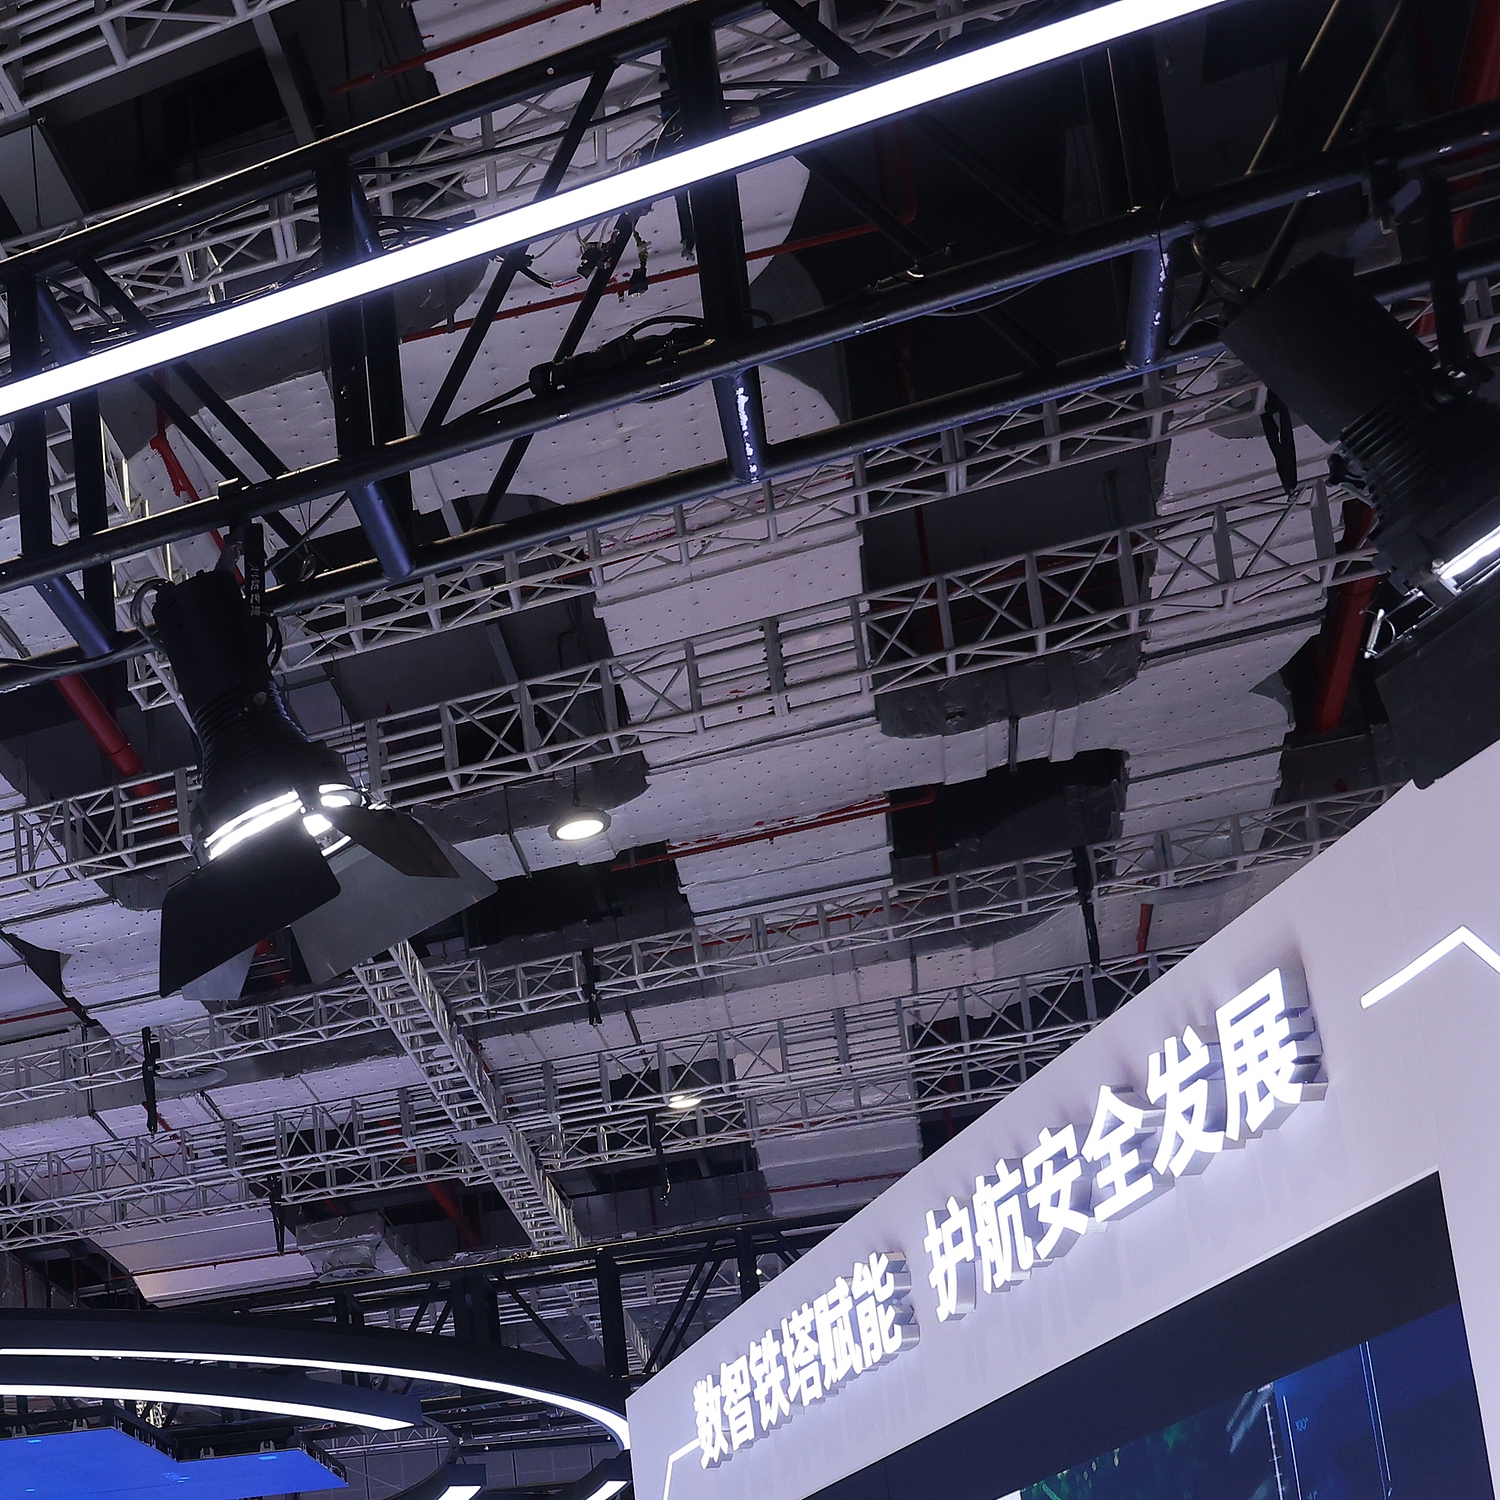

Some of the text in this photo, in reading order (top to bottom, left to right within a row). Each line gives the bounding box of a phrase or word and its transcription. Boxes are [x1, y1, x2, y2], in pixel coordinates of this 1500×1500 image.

[692, 967, 1304, 1470] 数智铁塔赋能 护航安全发展
